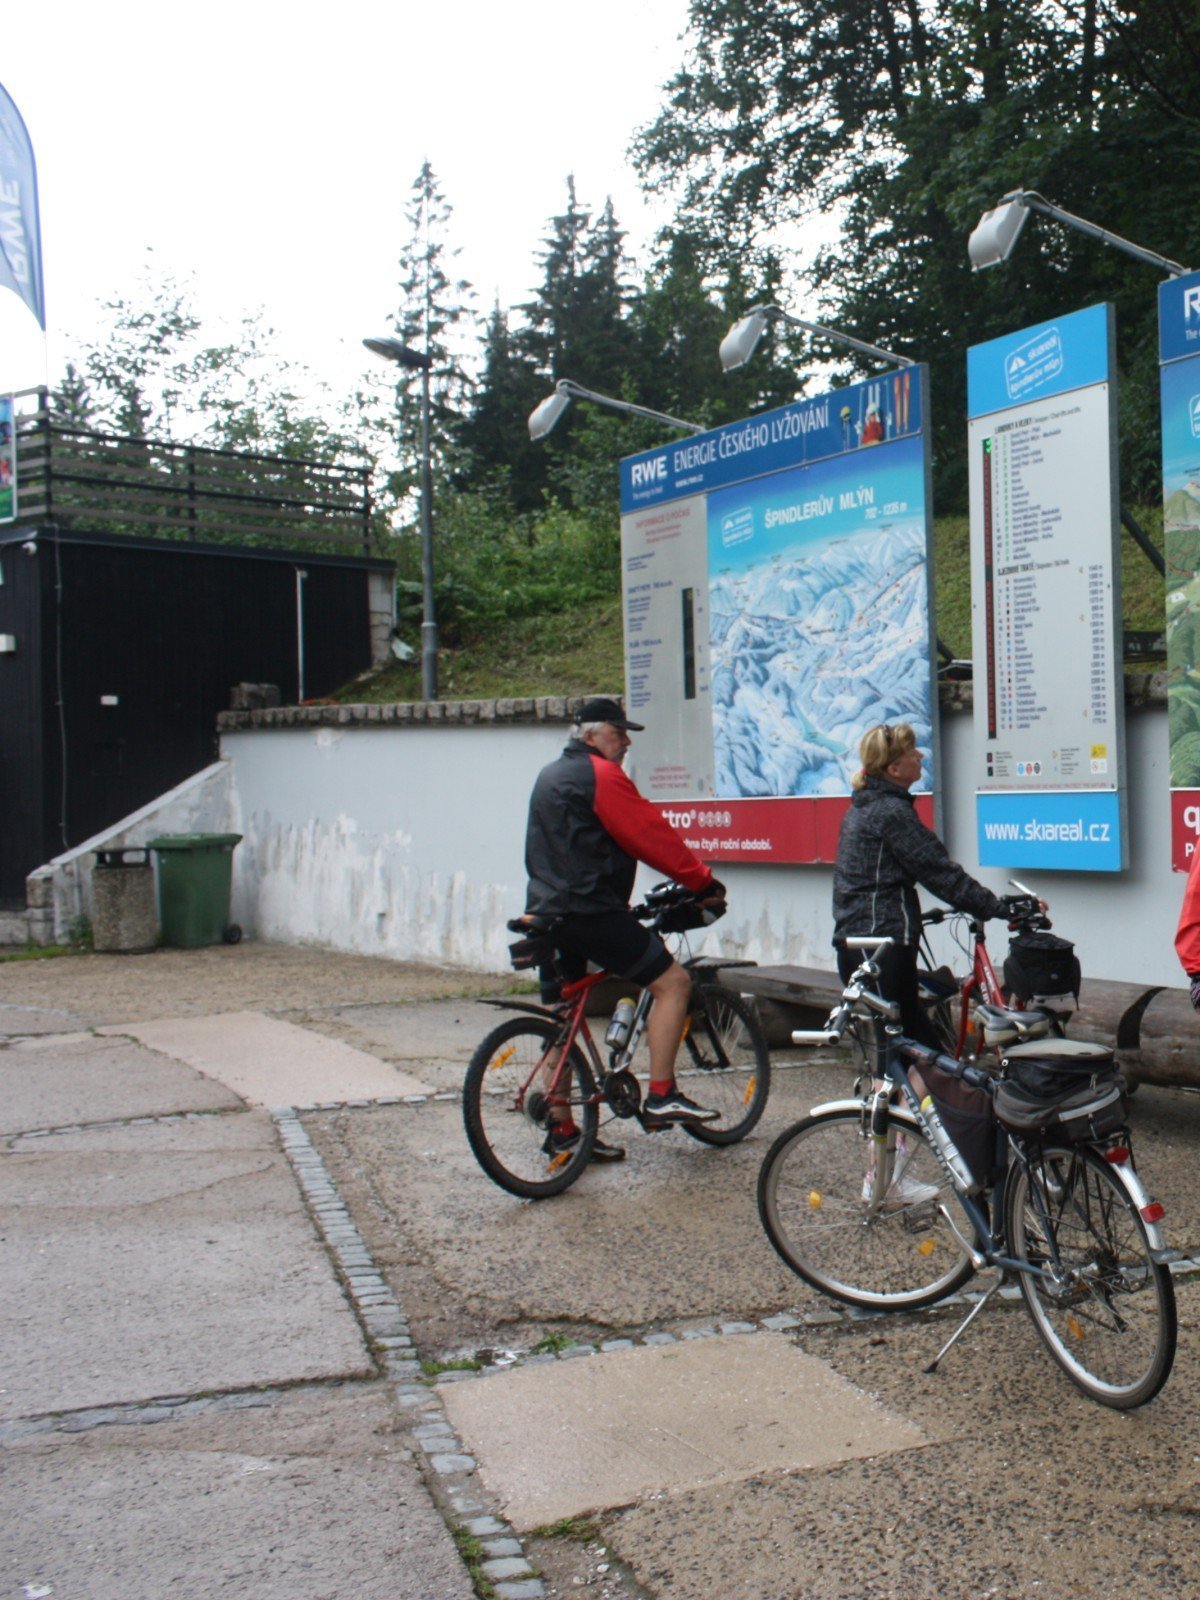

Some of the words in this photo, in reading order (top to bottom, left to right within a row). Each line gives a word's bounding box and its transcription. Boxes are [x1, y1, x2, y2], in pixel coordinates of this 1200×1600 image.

[631, 455, 668, 486] RWE
[674, 439, 717, 473] ENERGIE
[718, 423, 769, 459] ČESKÉHO
[771, 398, 829, 443] LYŽOVÁNÍ
[764, 494, 834, 528] ŠPINDLERŮV
[839, 485, 874, 510] MLÝN
